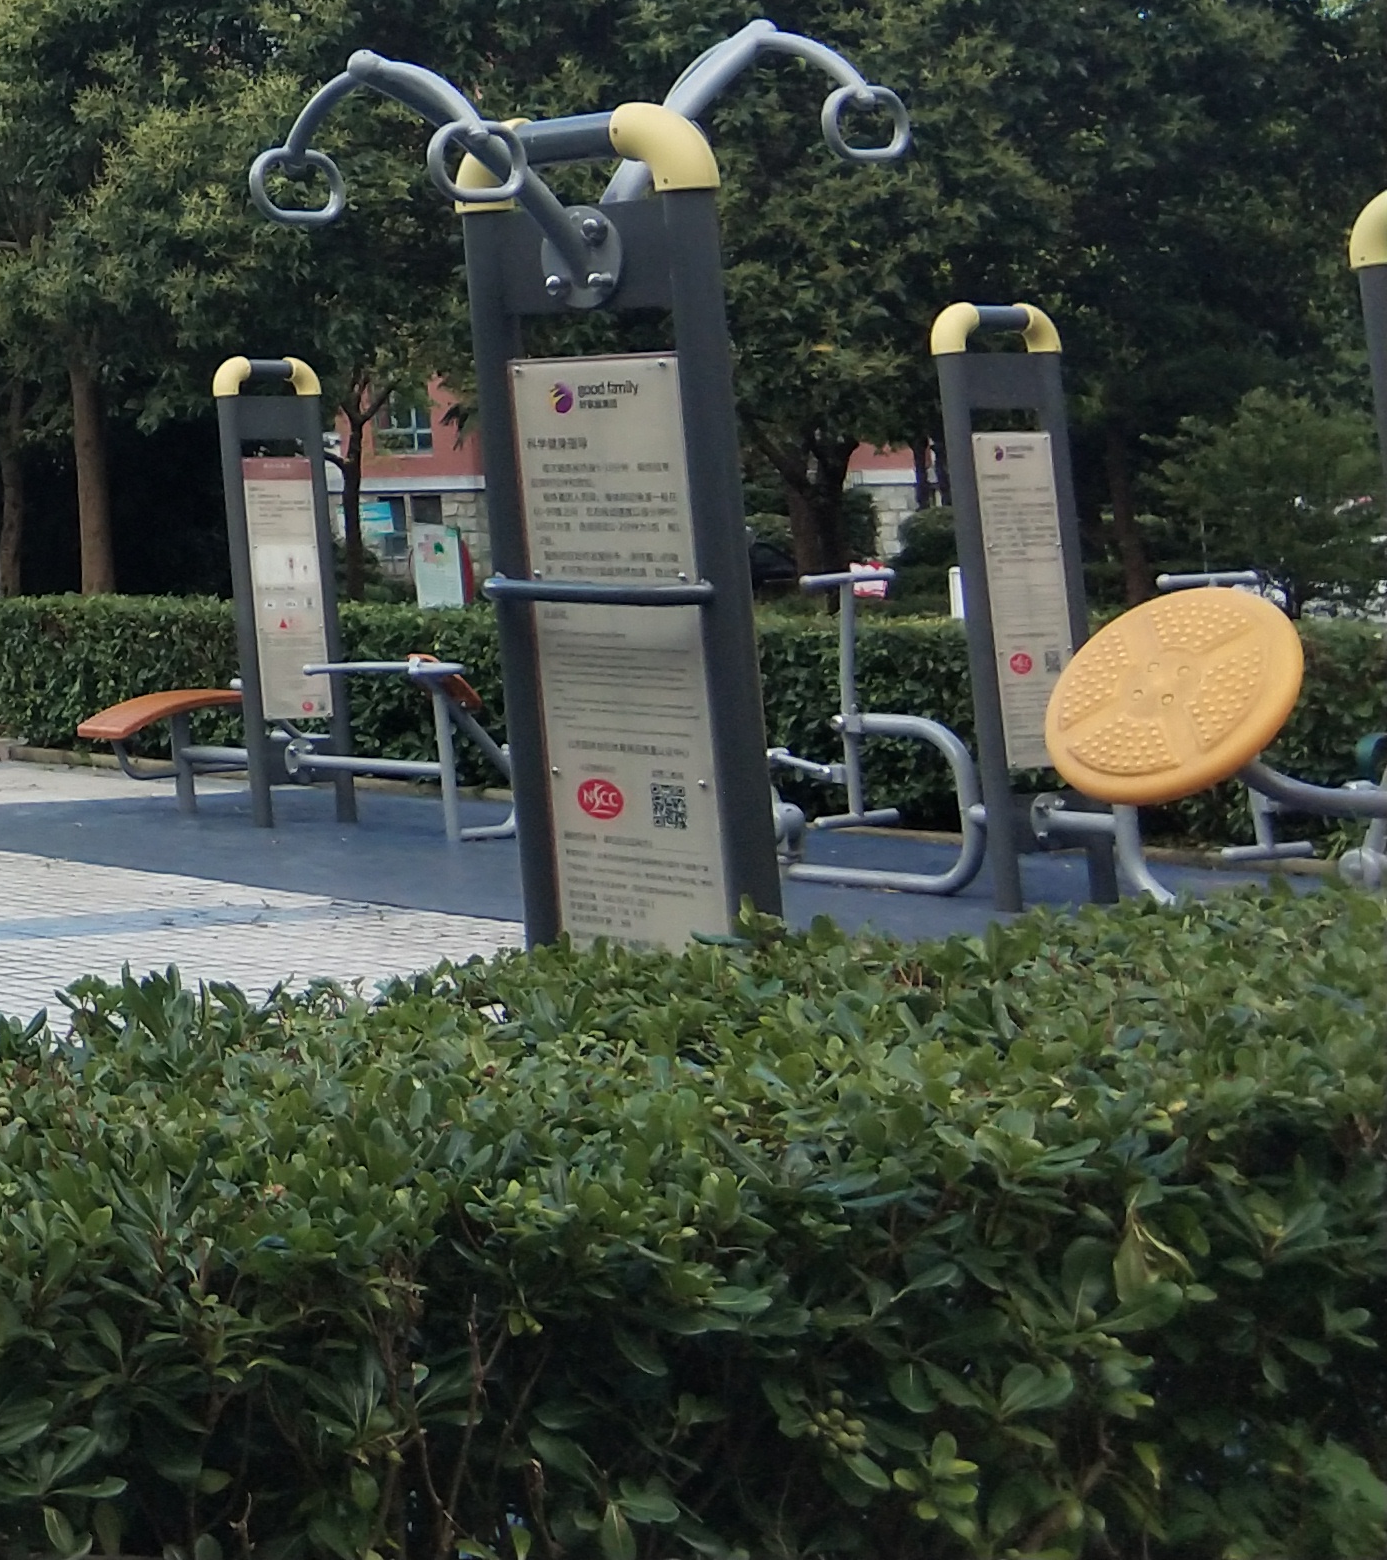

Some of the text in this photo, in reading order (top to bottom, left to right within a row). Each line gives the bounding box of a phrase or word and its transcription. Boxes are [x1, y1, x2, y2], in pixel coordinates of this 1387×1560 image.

[578, 380, 639, 397] good family
[583, 783, 619, 811] NSCC
